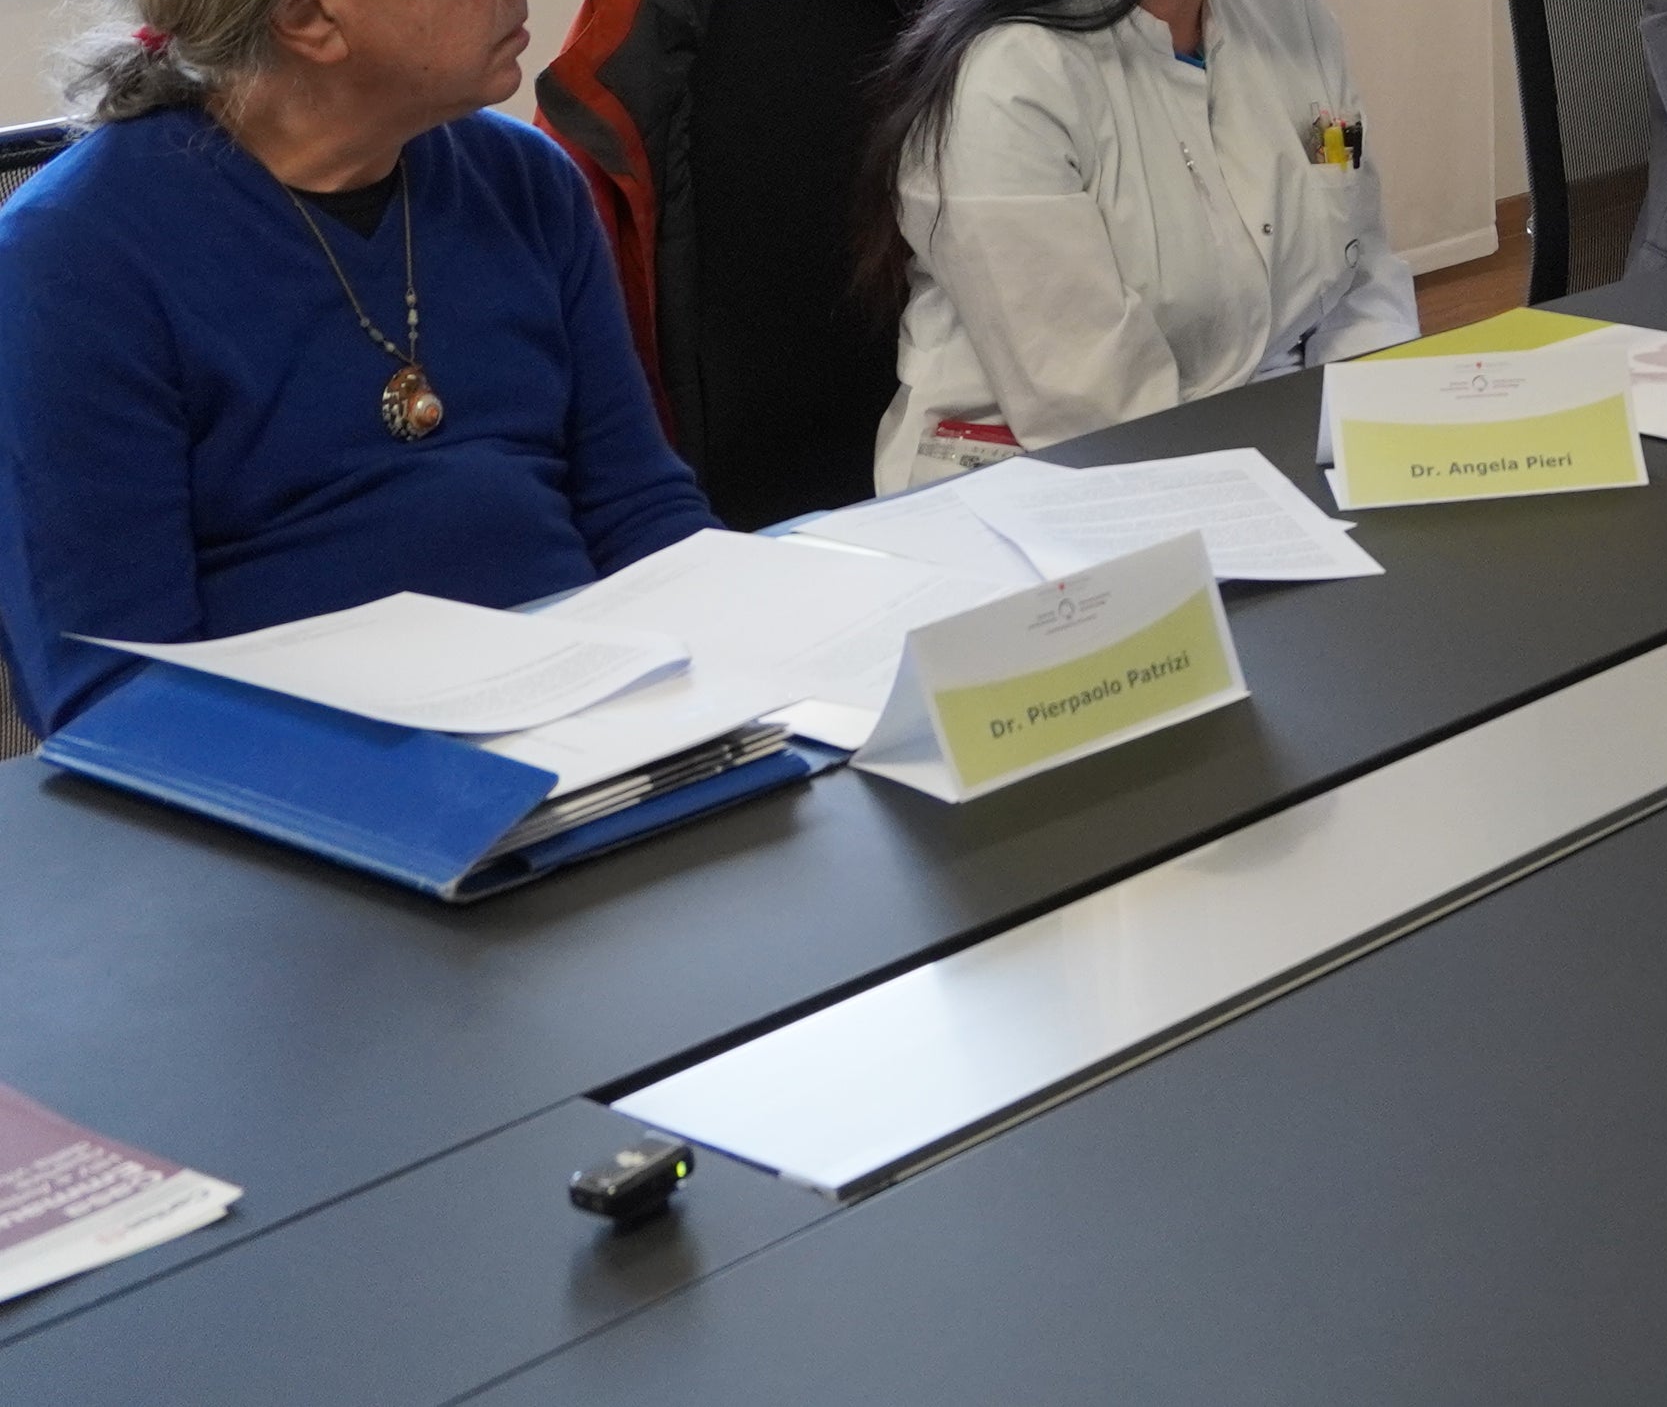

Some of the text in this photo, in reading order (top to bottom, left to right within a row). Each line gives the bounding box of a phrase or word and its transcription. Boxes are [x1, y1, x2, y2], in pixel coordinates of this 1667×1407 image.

[1410, 453, 1574, 479] Dr. Angela Pieri
[990, 649, 1191, 740] Dr. Pierpaolo Patrizi
